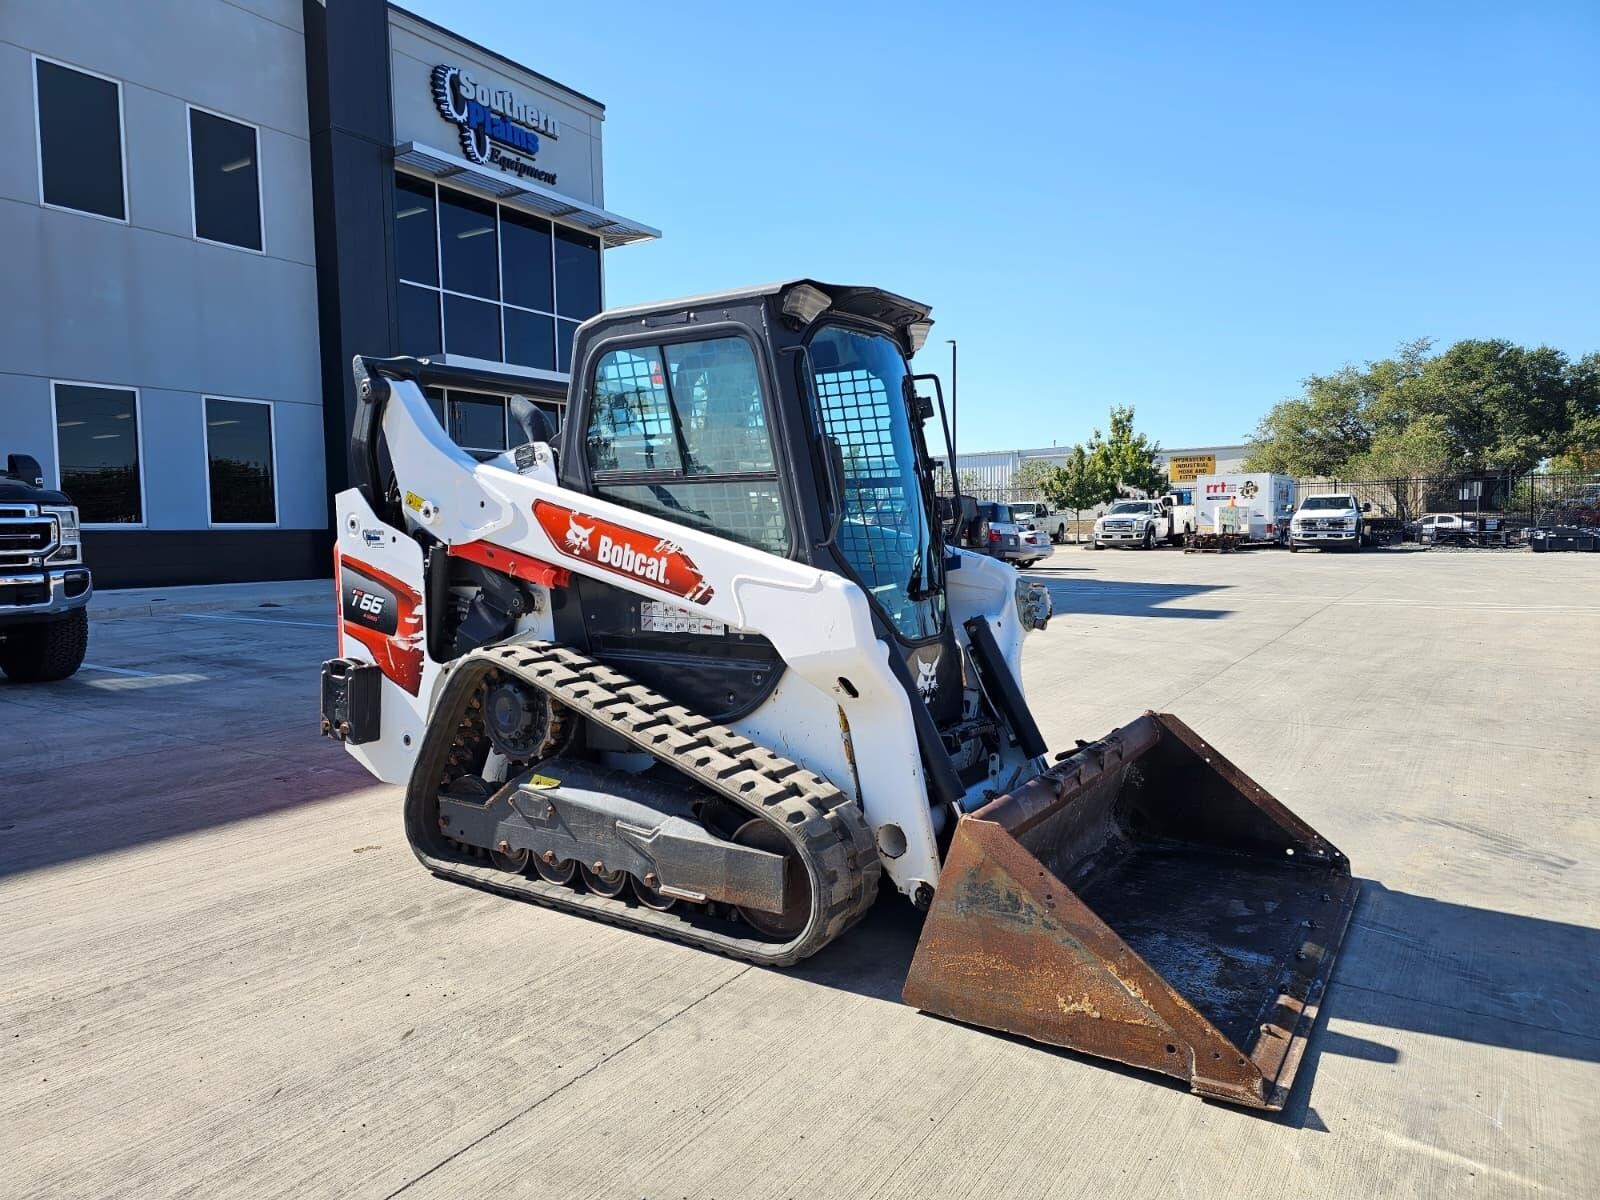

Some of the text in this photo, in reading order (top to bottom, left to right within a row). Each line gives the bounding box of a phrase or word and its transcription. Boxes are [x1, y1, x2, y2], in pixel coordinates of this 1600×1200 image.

[459, 69, 560, 138] Southern
[467, 101, 539, 155] Plains
[490, 148, 558, 186] Equipment
[1206, 481, 1226, 494] rrt
[597, 535, 668, 584] Bobcat
[352, 588, 385, 614] T66
